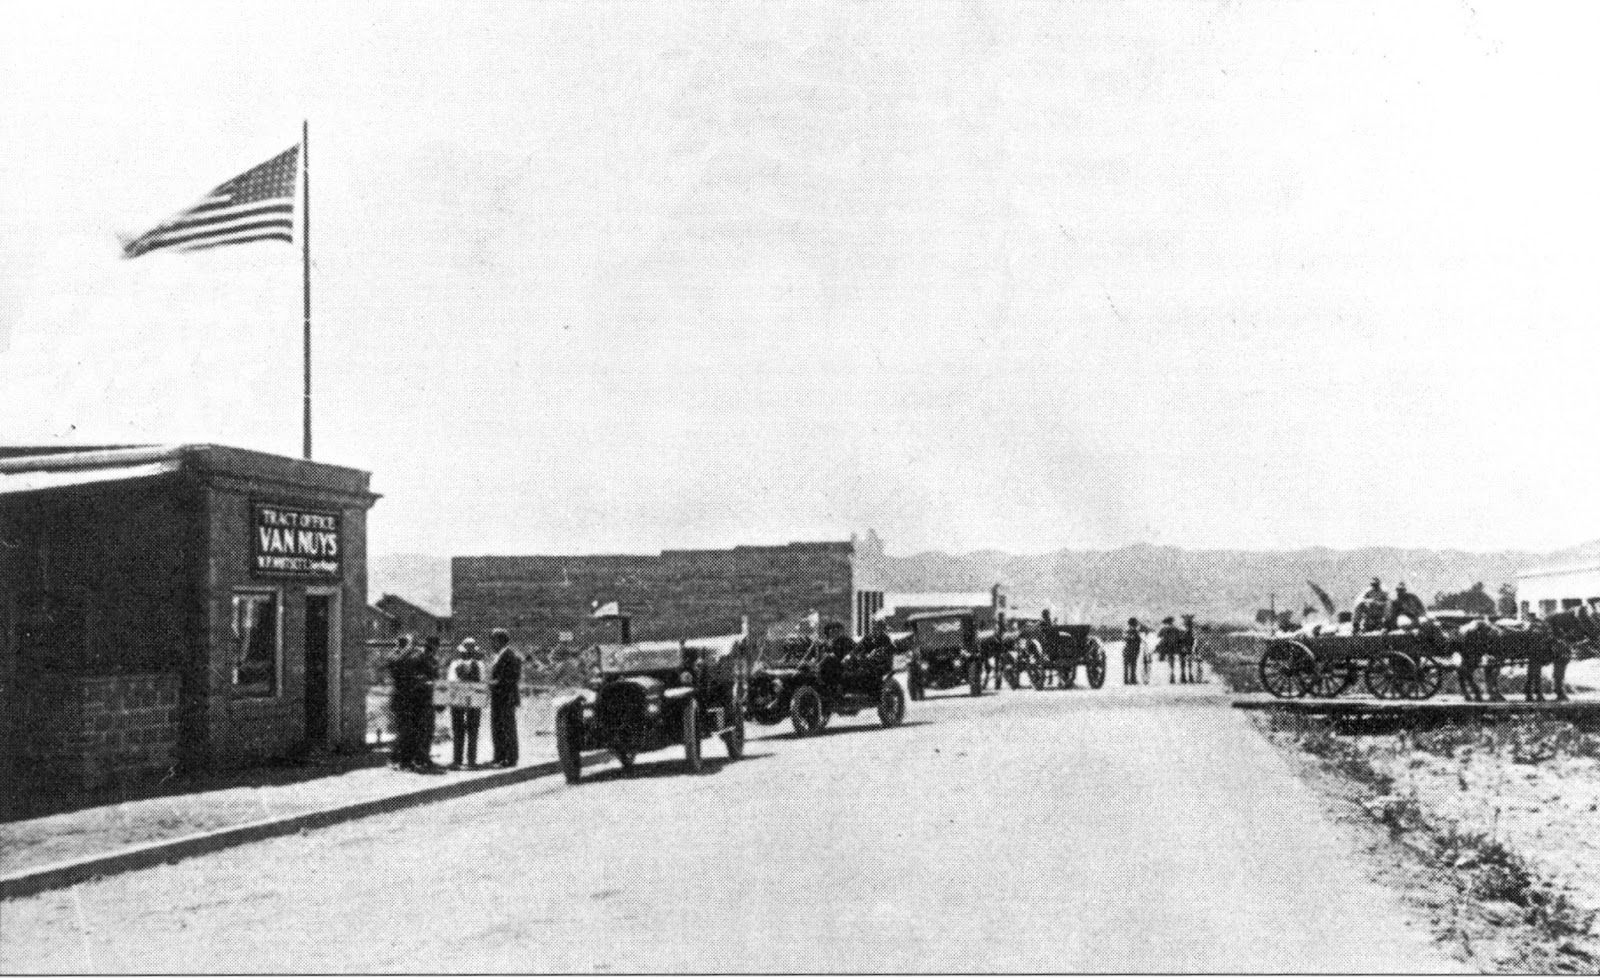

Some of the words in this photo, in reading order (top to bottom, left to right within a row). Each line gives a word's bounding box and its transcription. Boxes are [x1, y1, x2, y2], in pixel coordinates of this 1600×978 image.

[263, 509, 298, 525] TRACT
[300, 514, 335, 530] OFFICE
[259, 526, 295, 553] VAN
[298, 530, 337, 555] NUYS
